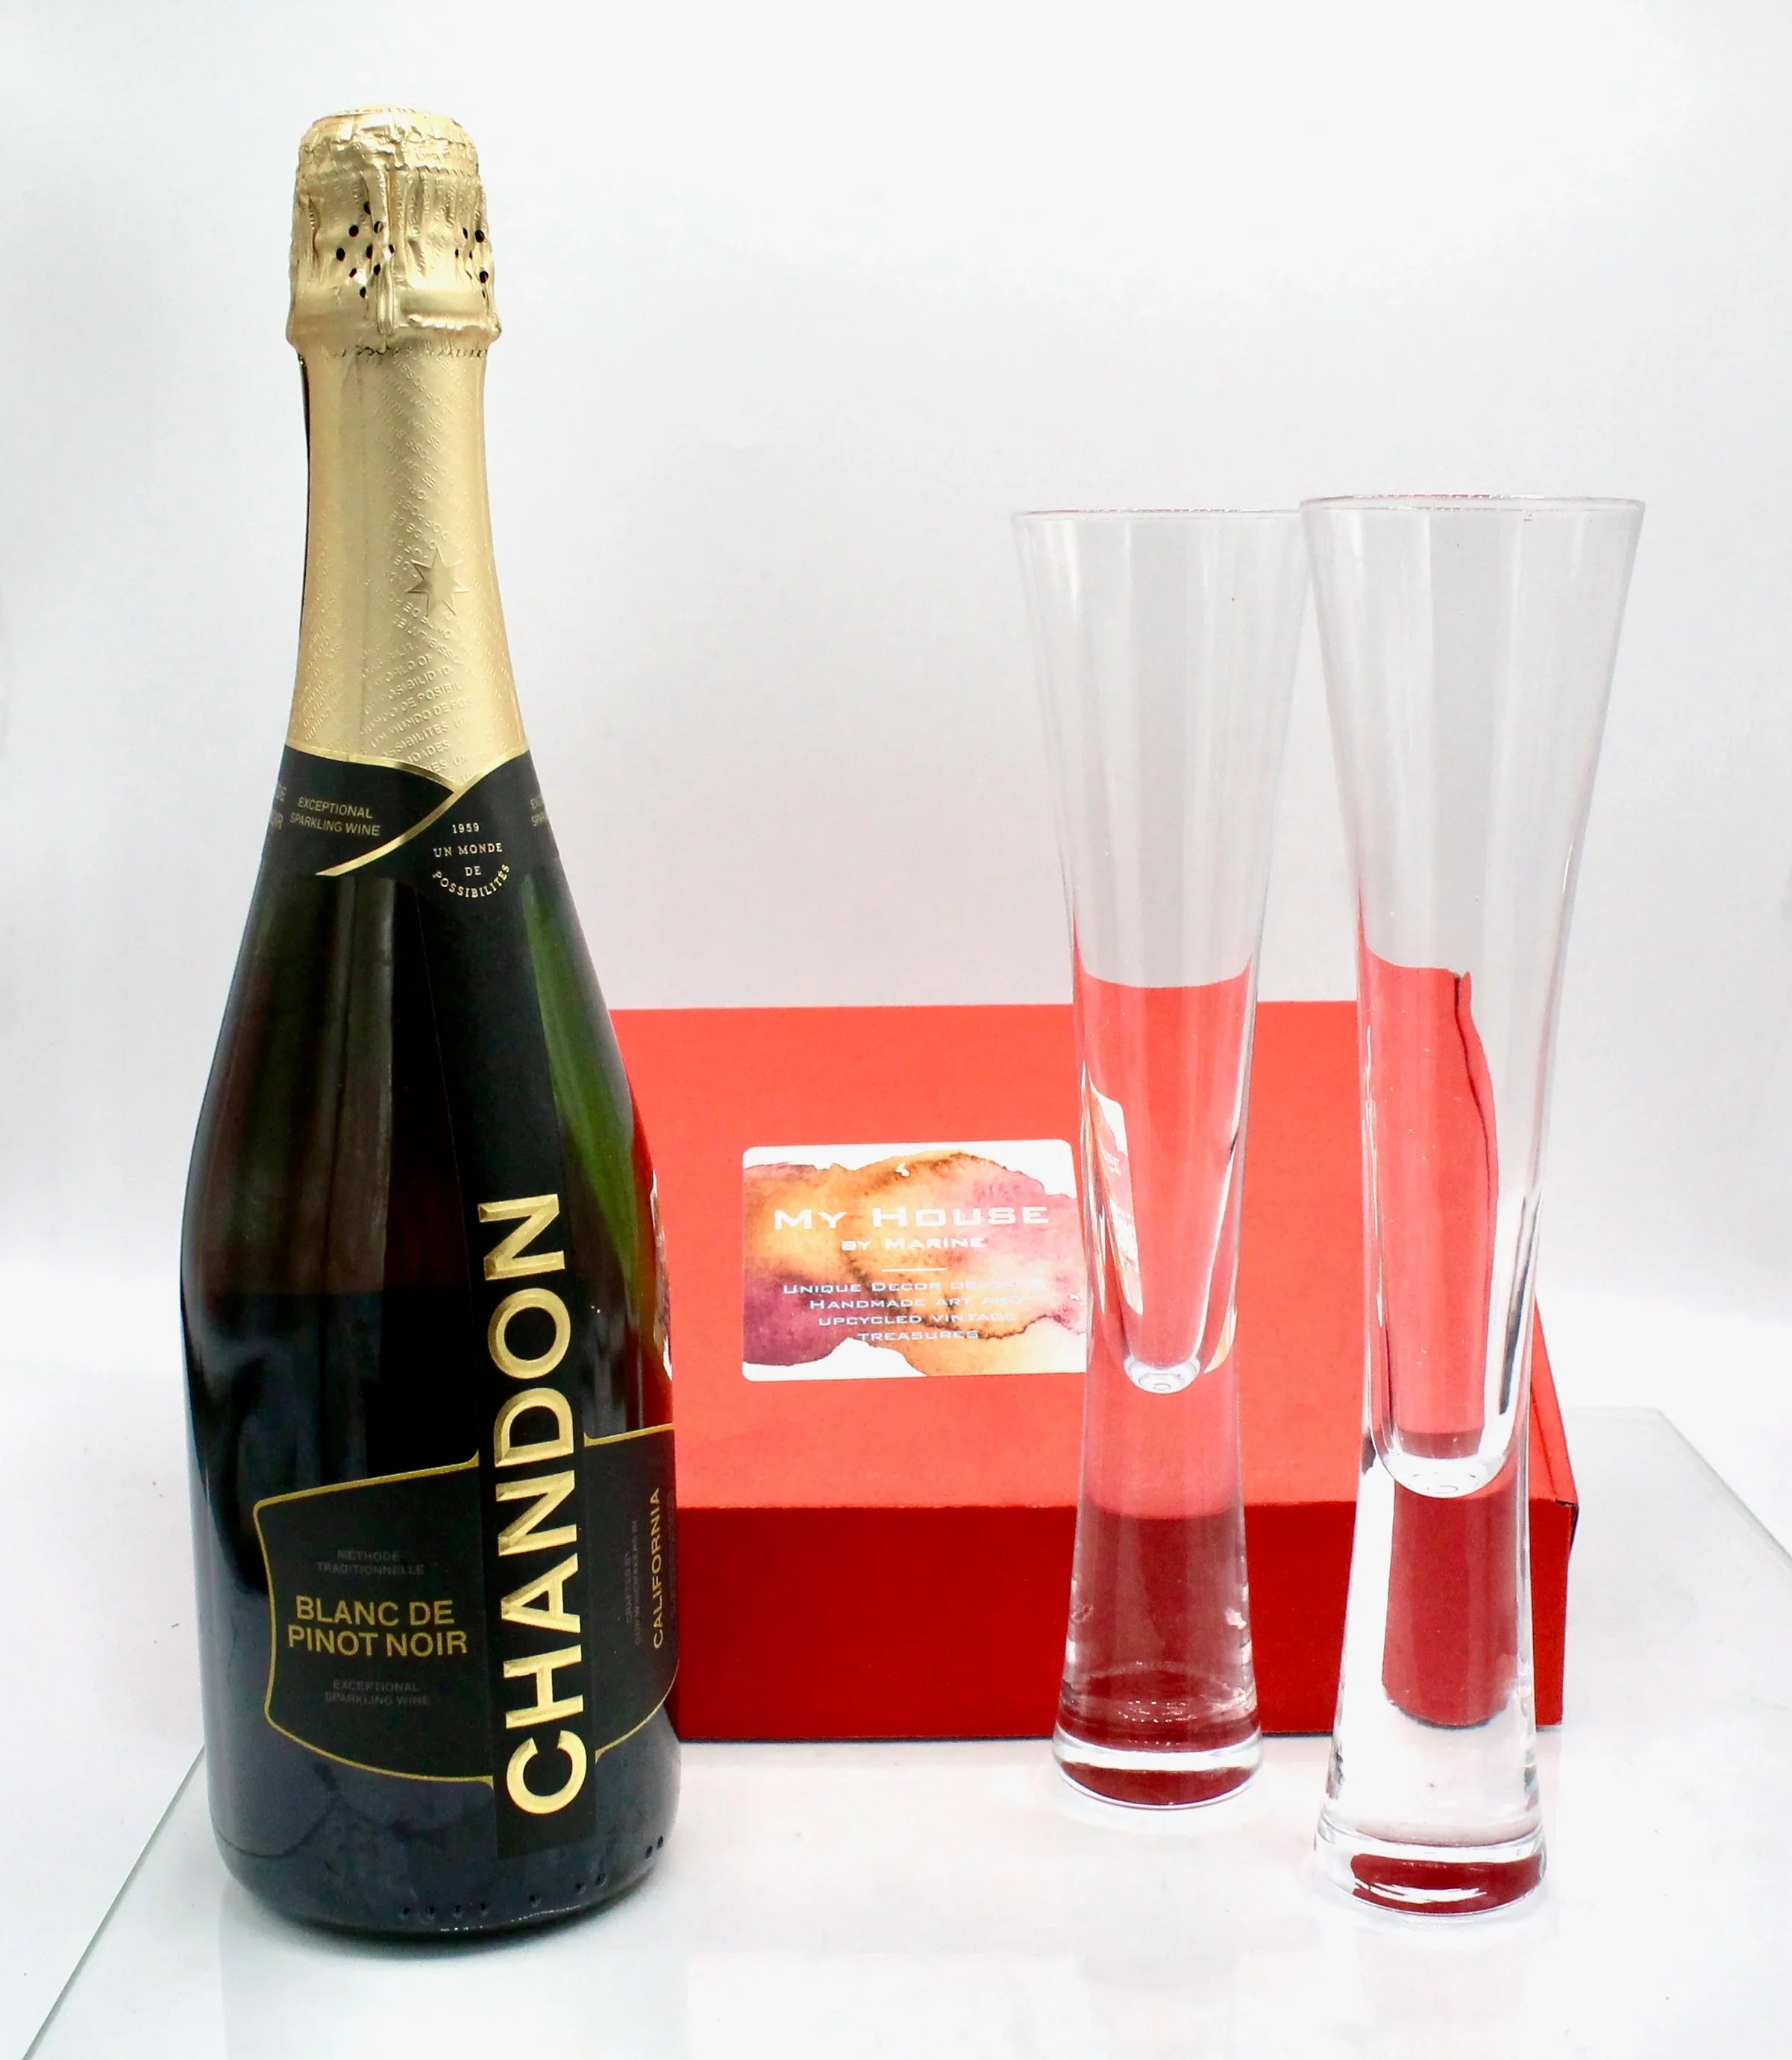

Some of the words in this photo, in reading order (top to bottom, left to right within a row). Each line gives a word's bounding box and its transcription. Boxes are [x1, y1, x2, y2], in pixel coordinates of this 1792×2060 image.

[297, 796, 374, 819] EXCEPTIONAL
[289, 812, 343, 833] SPARKLING
[345, 821, 382, 837] WINE
[451, 822, 480, 834] 1959
[433, 846, 452, 858] UN
[457, 842, 503, 855] MONDE
[464, 865, 482, 877] DE
[477, 1192, 588, 1815] CHANDON
[650, 1487, 663, 1650] CALIFORNIA
[295, 1595, 400, 1627] BLANC
[409, 1599, 455, 1626] DE
[287, 1624, 378, 1656] PINOT
[386, 1630, 469, 1658] NOIR
